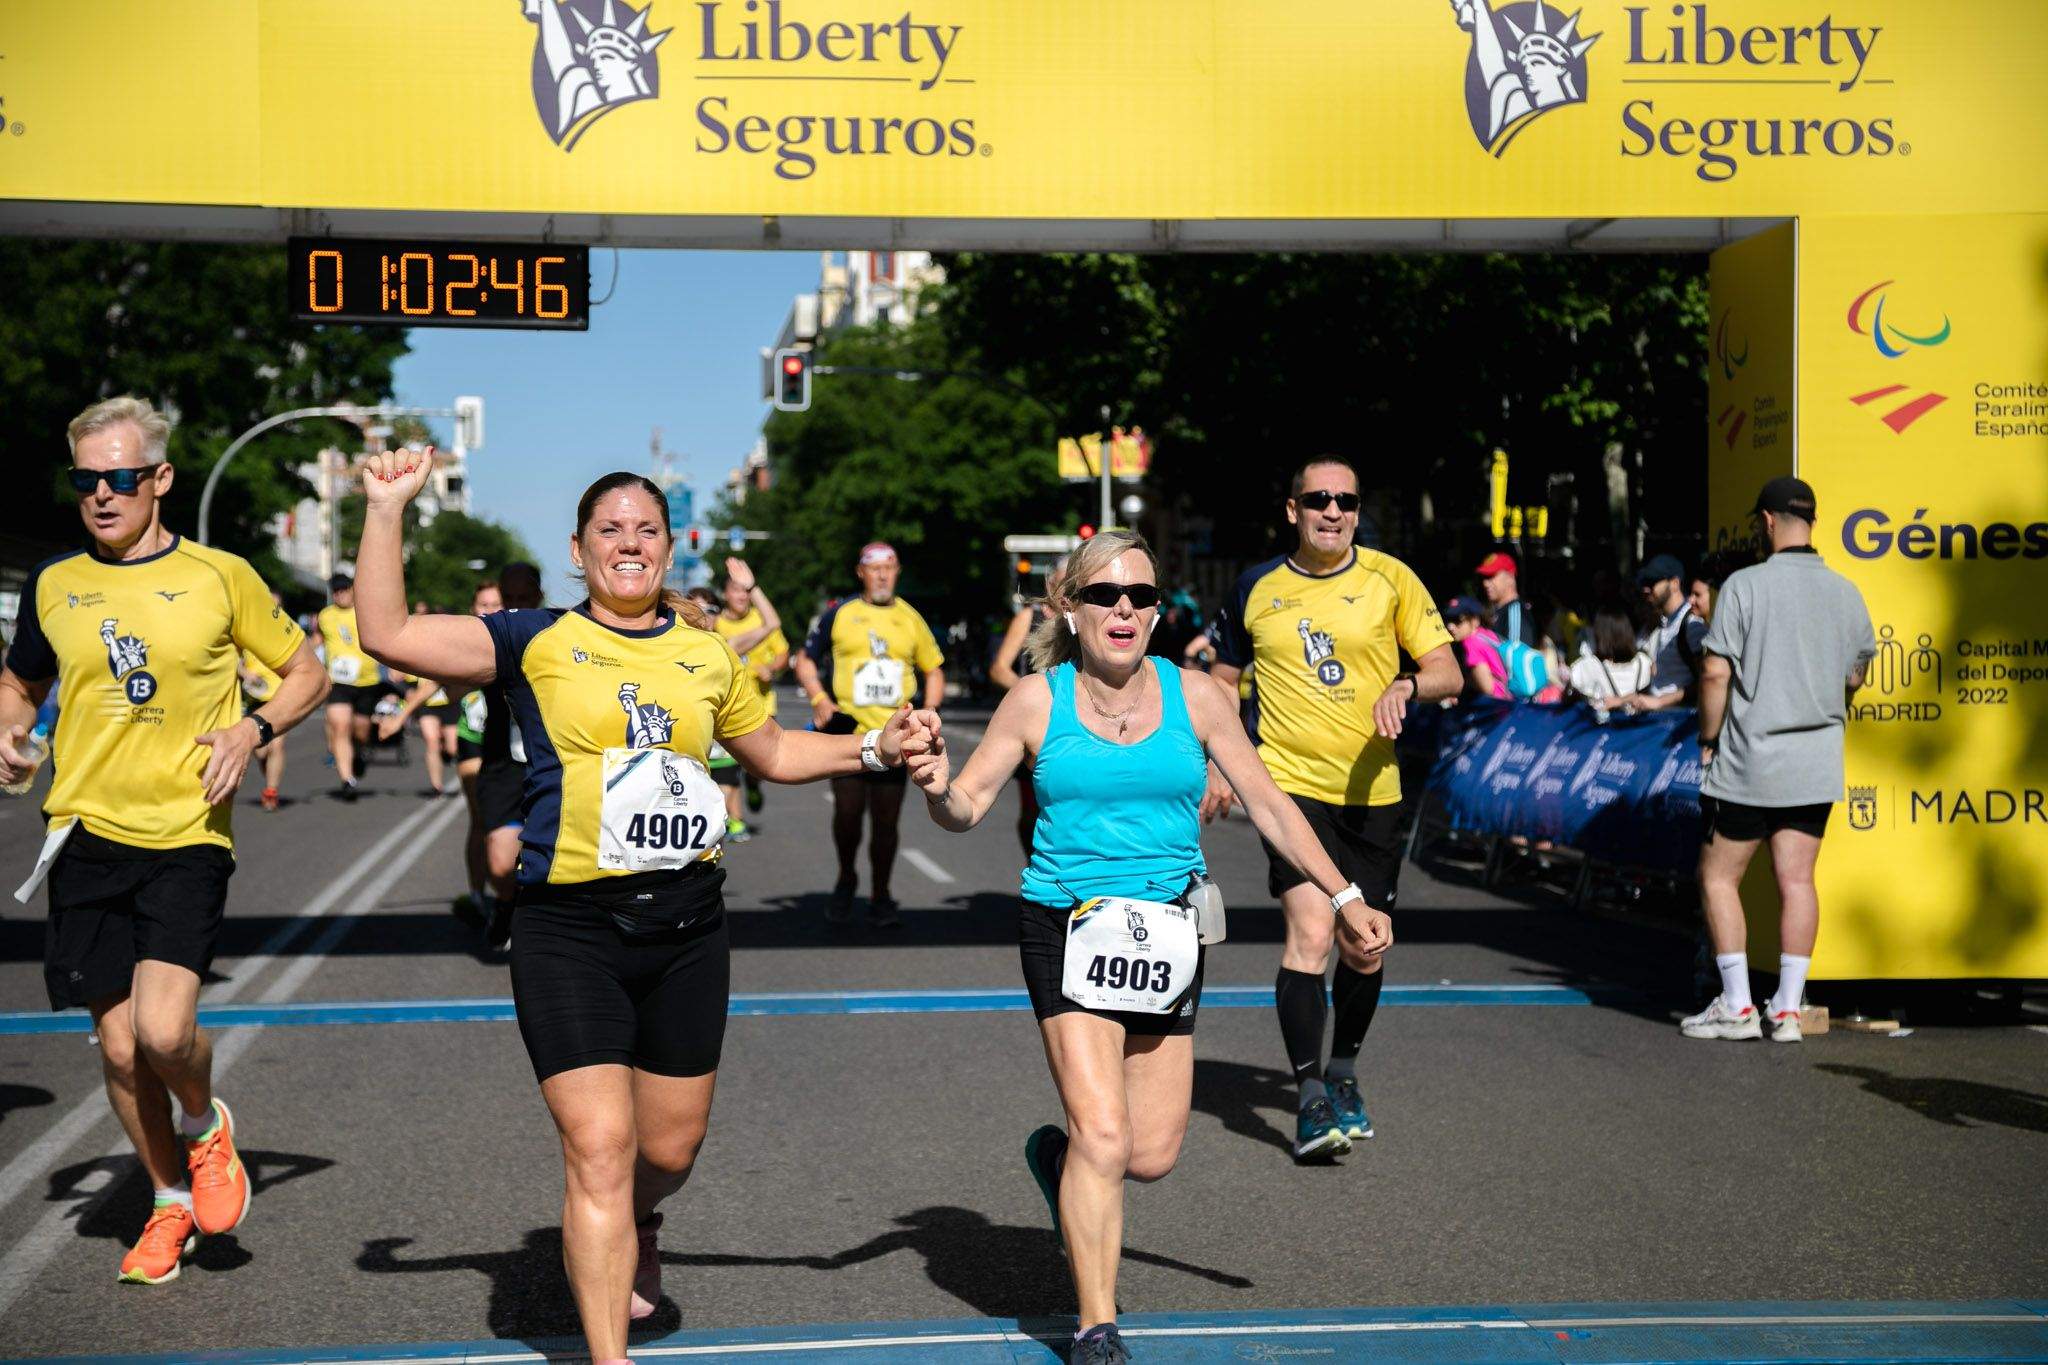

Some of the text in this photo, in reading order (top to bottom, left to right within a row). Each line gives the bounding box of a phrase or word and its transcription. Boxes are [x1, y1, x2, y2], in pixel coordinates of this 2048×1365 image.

[697, 0, 963, 91] Liberty
[1624, 3, 1883, 92] Liberty
[695, 97, 976, 180] Seguros
[1621, 100, 1895, 182] Seguros
[1841, 507, 2048, 560] Génes
[1957, 640, 2028, 660] Capital
[131, 678, 151, 698] 13
[1323, 664, 1341, 681] 13
[1957, 664, 1986, 681] del
[1957, 688, 2009, 704] 2022
[672, 783, 683, 793] 13
[1911, 789, 2048, 823] MADR
[625, 812, 709, 850] 4902
[1135, 929, 1146, 940] 13
[1086, 954, 1172, 994] 4903
